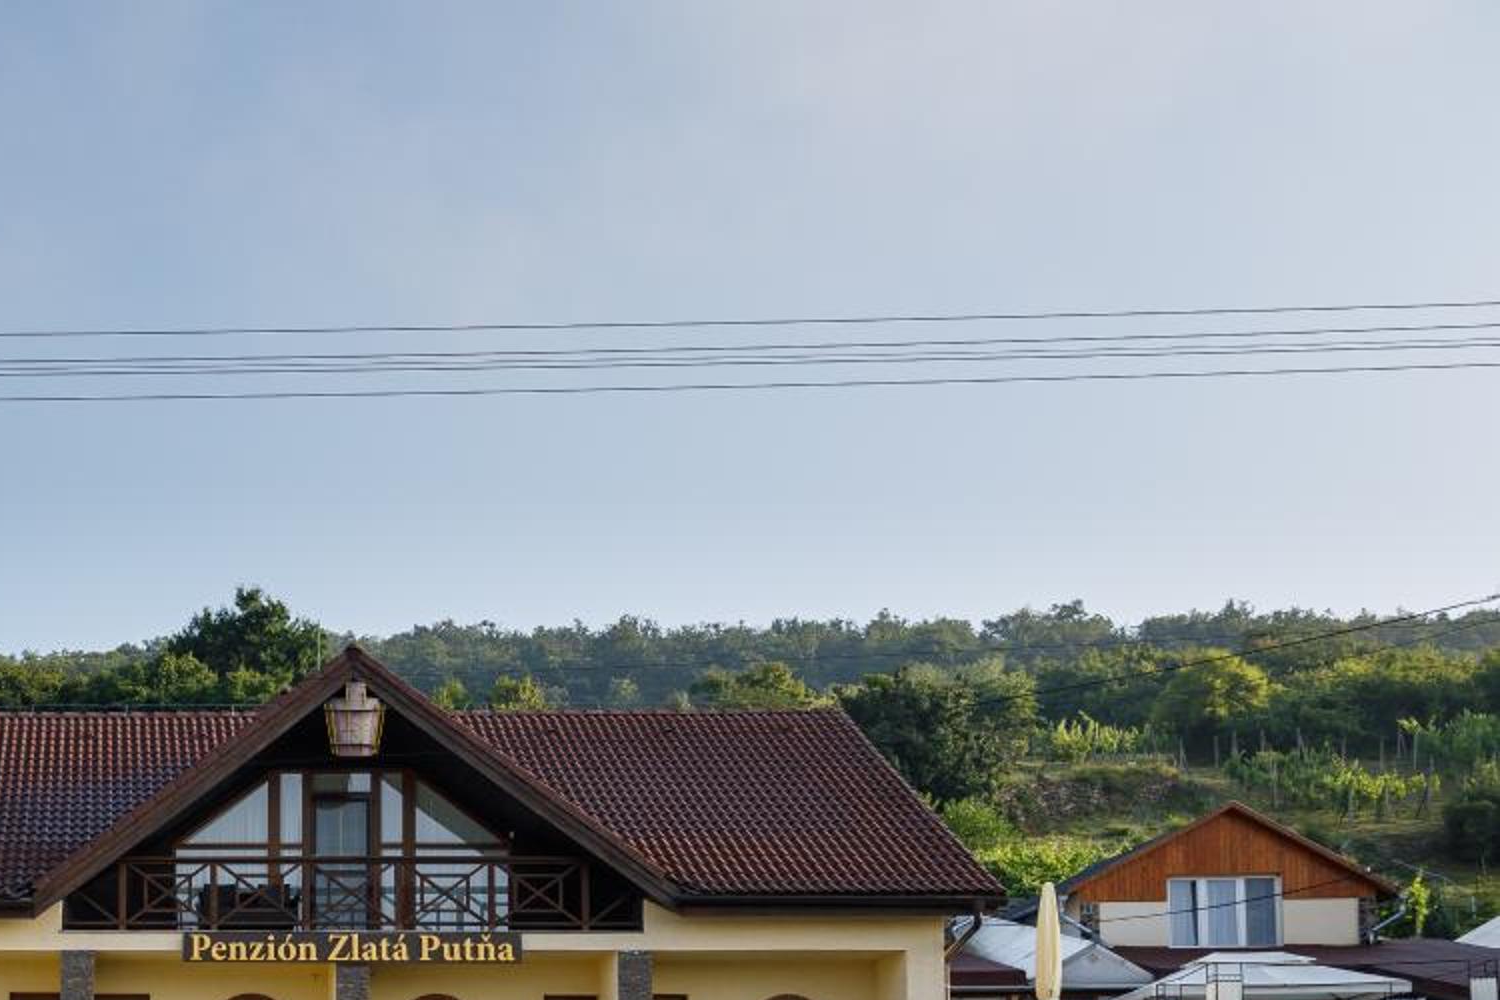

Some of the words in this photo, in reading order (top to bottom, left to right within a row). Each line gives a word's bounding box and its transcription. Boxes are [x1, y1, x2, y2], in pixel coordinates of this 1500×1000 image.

[189, 933, 318, 961] Penzión
[327, 933, 409, 961] Zlatá
[419, 933, 515, 961] Putňa
